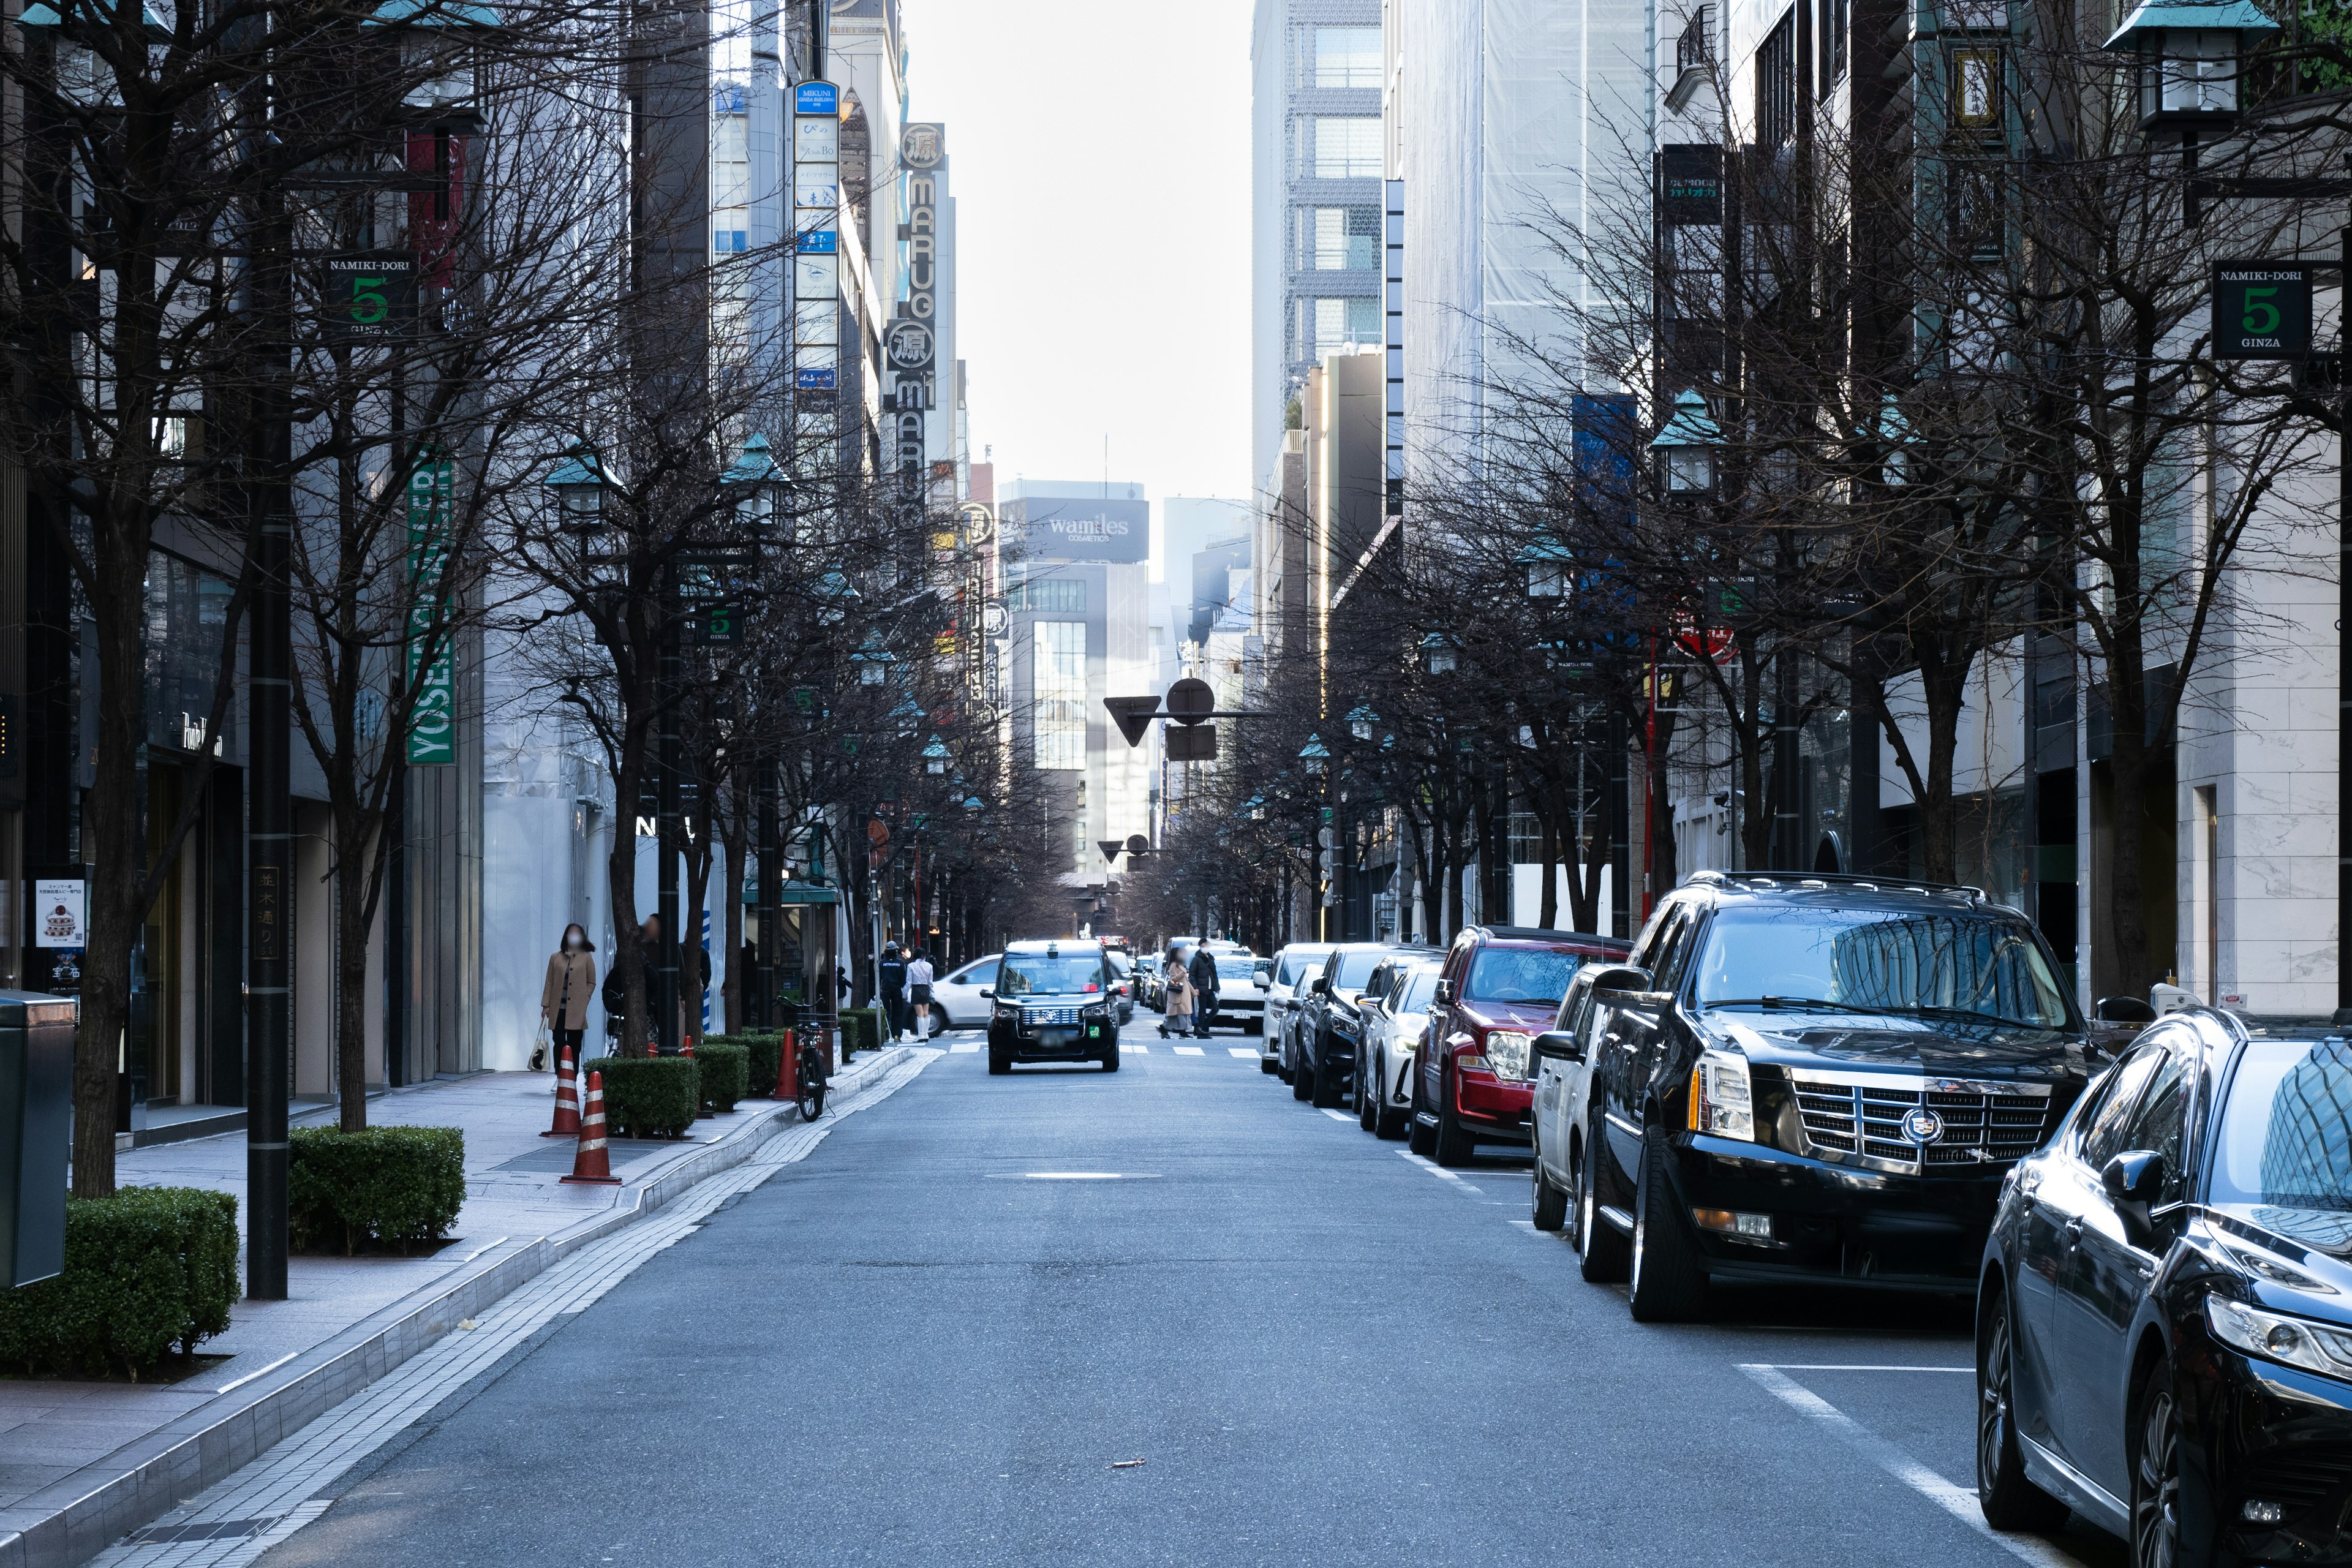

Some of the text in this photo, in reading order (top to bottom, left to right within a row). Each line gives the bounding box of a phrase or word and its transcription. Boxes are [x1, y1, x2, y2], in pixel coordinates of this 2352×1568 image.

[330, 261, 410, 270] NAMIKI-DORI
[2220, 271, 2302, 281] NAMIKI-DORI
[350, 277, 388, 323] 5
[2242, 287, 2281, 334] 5
[2241, 339, 2282, 347] GINZA
[1049, 513, 1129, 535] wamiles
[710, 610, 731, 634] 5
[257, 873, 276, 944] 並木通り
